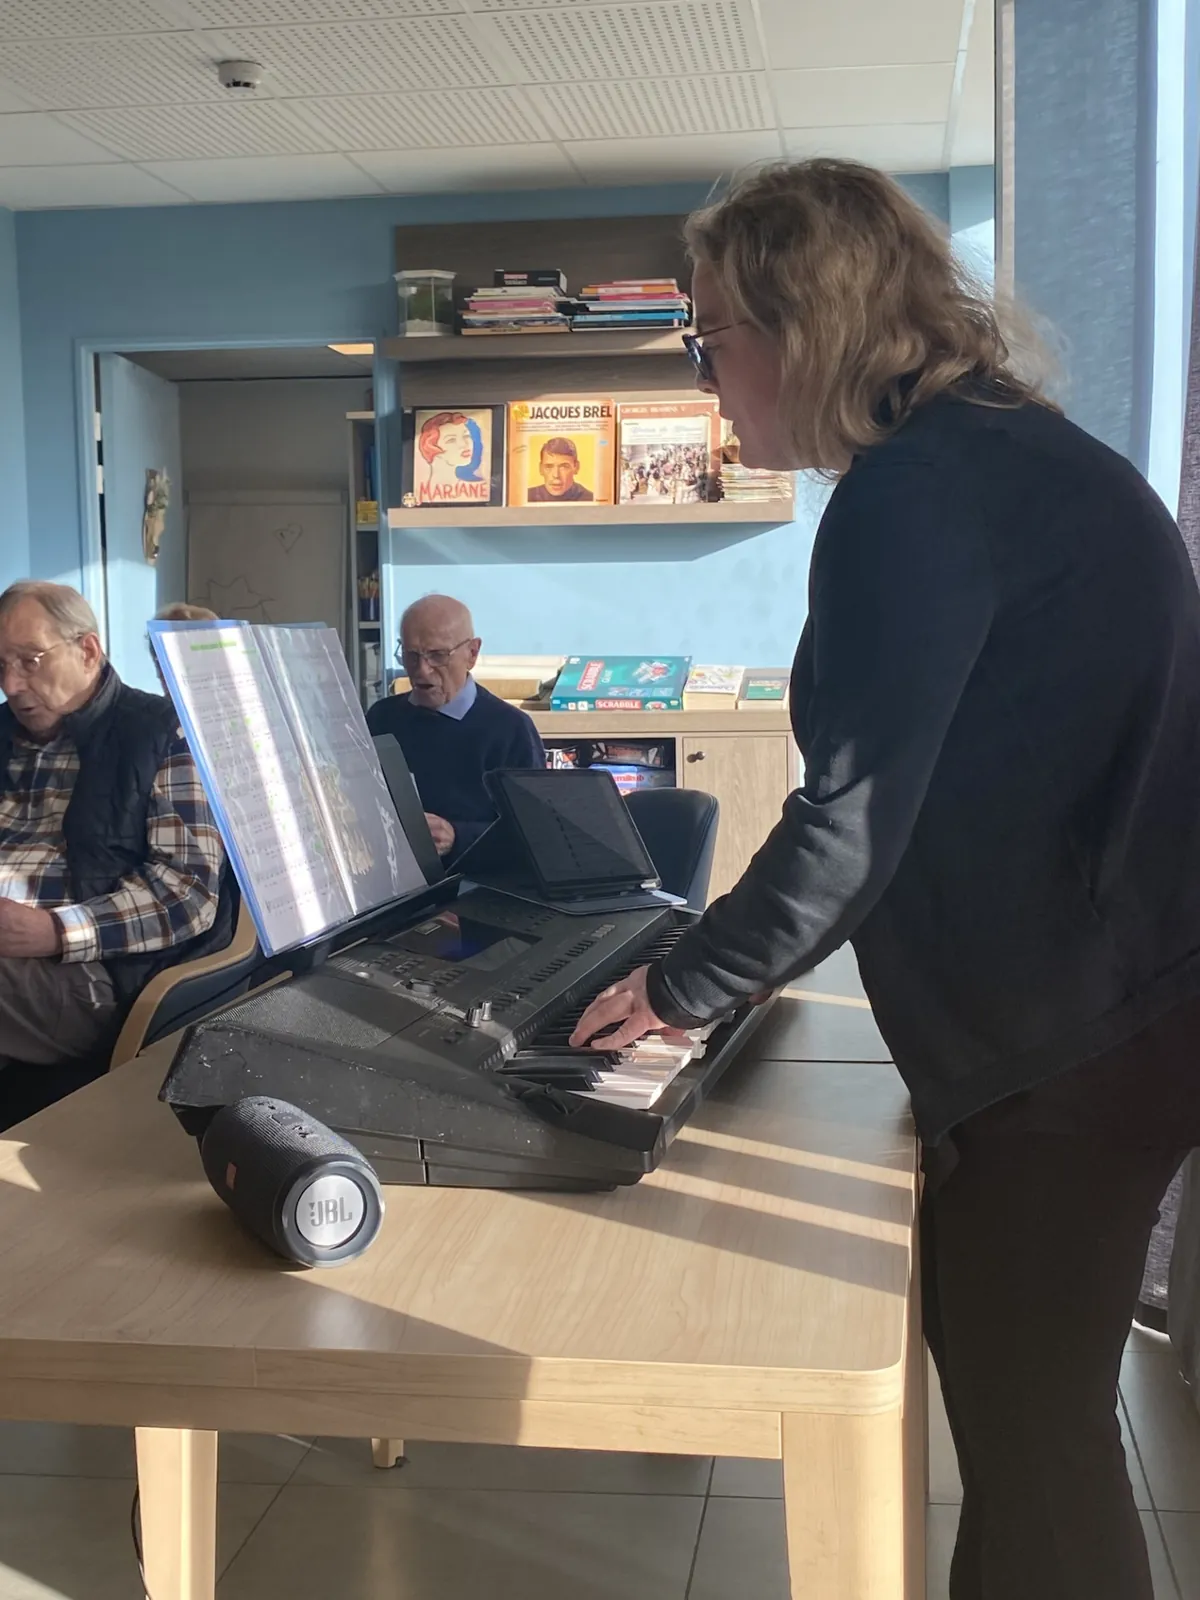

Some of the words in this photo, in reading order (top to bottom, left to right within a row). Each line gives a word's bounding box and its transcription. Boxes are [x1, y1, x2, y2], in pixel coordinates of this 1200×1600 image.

[529, 406, 581, 420] JACQUES
[583, 405, 613, 419] BREL
[597, 700, 641, 710] SCRABBLE
[309, 1197, 353, 1228] JBL
